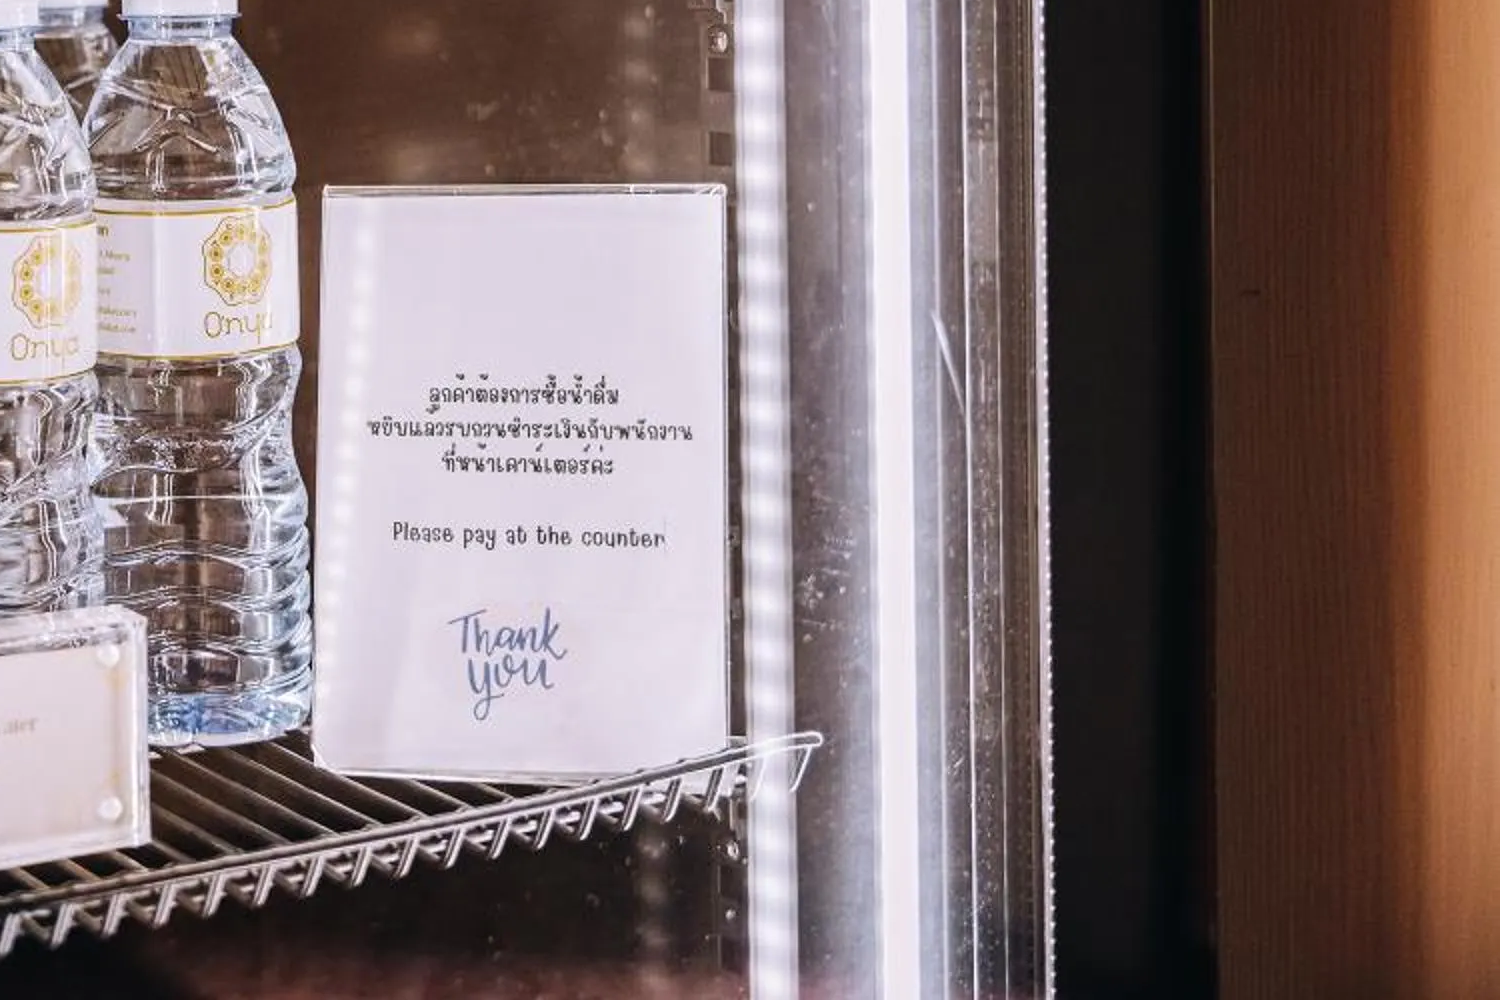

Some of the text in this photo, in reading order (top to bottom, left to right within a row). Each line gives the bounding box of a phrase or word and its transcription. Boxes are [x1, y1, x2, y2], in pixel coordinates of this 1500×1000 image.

[392, 521, 666, 550] Please pay at the counter
[448, 606, 567, 660] Thank
[467, 654, 554, 721] you
